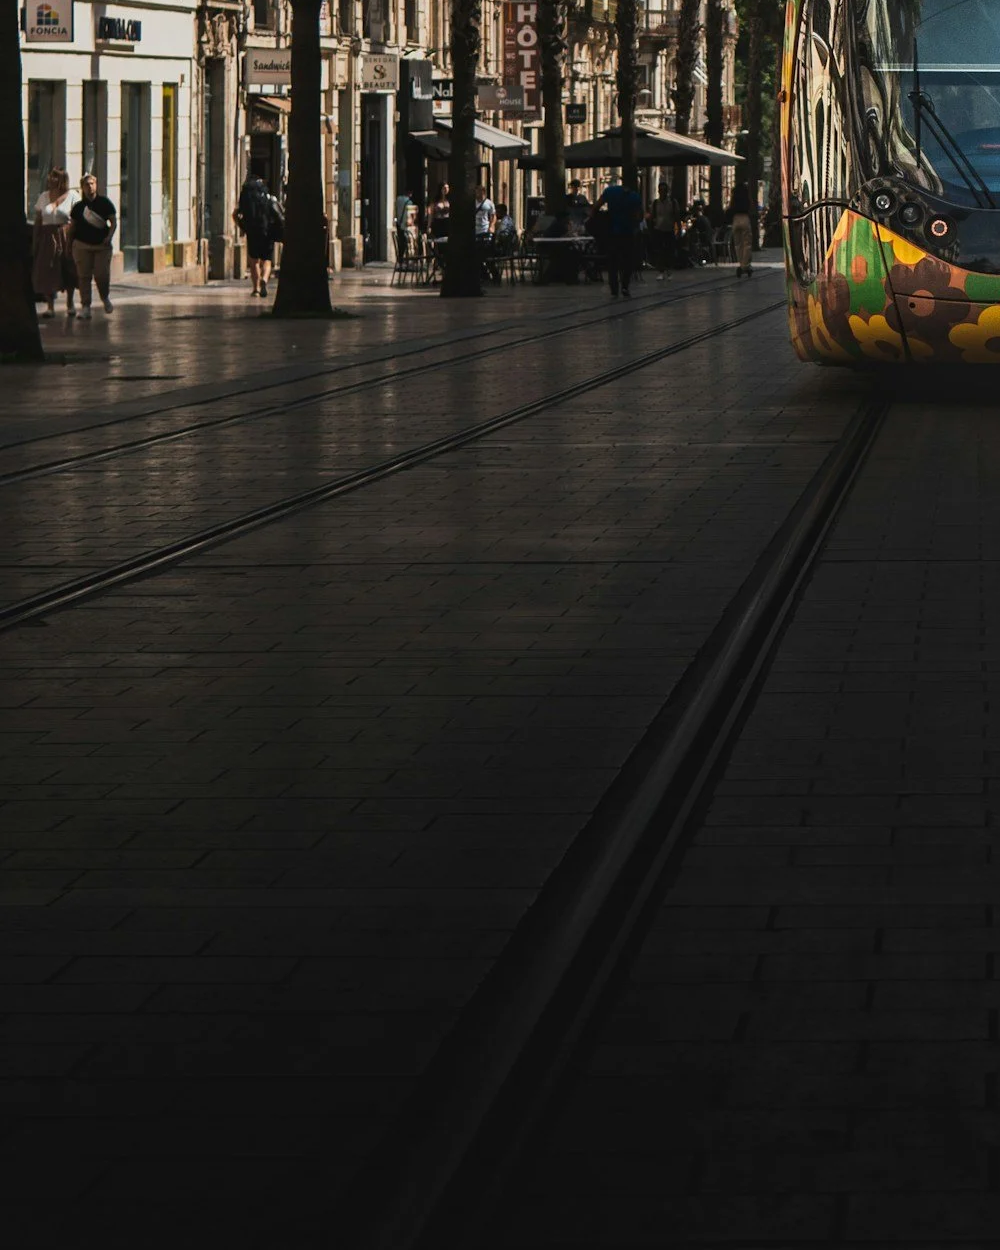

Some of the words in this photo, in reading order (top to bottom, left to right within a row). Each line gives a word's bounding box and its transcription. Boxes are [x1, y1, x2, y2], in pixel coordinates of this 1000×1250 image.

[30, 27, 68, 35] FONCIA
[517, 3, 538, 111] HÔTEL
[499, 98, 522, 106] HOUSE
